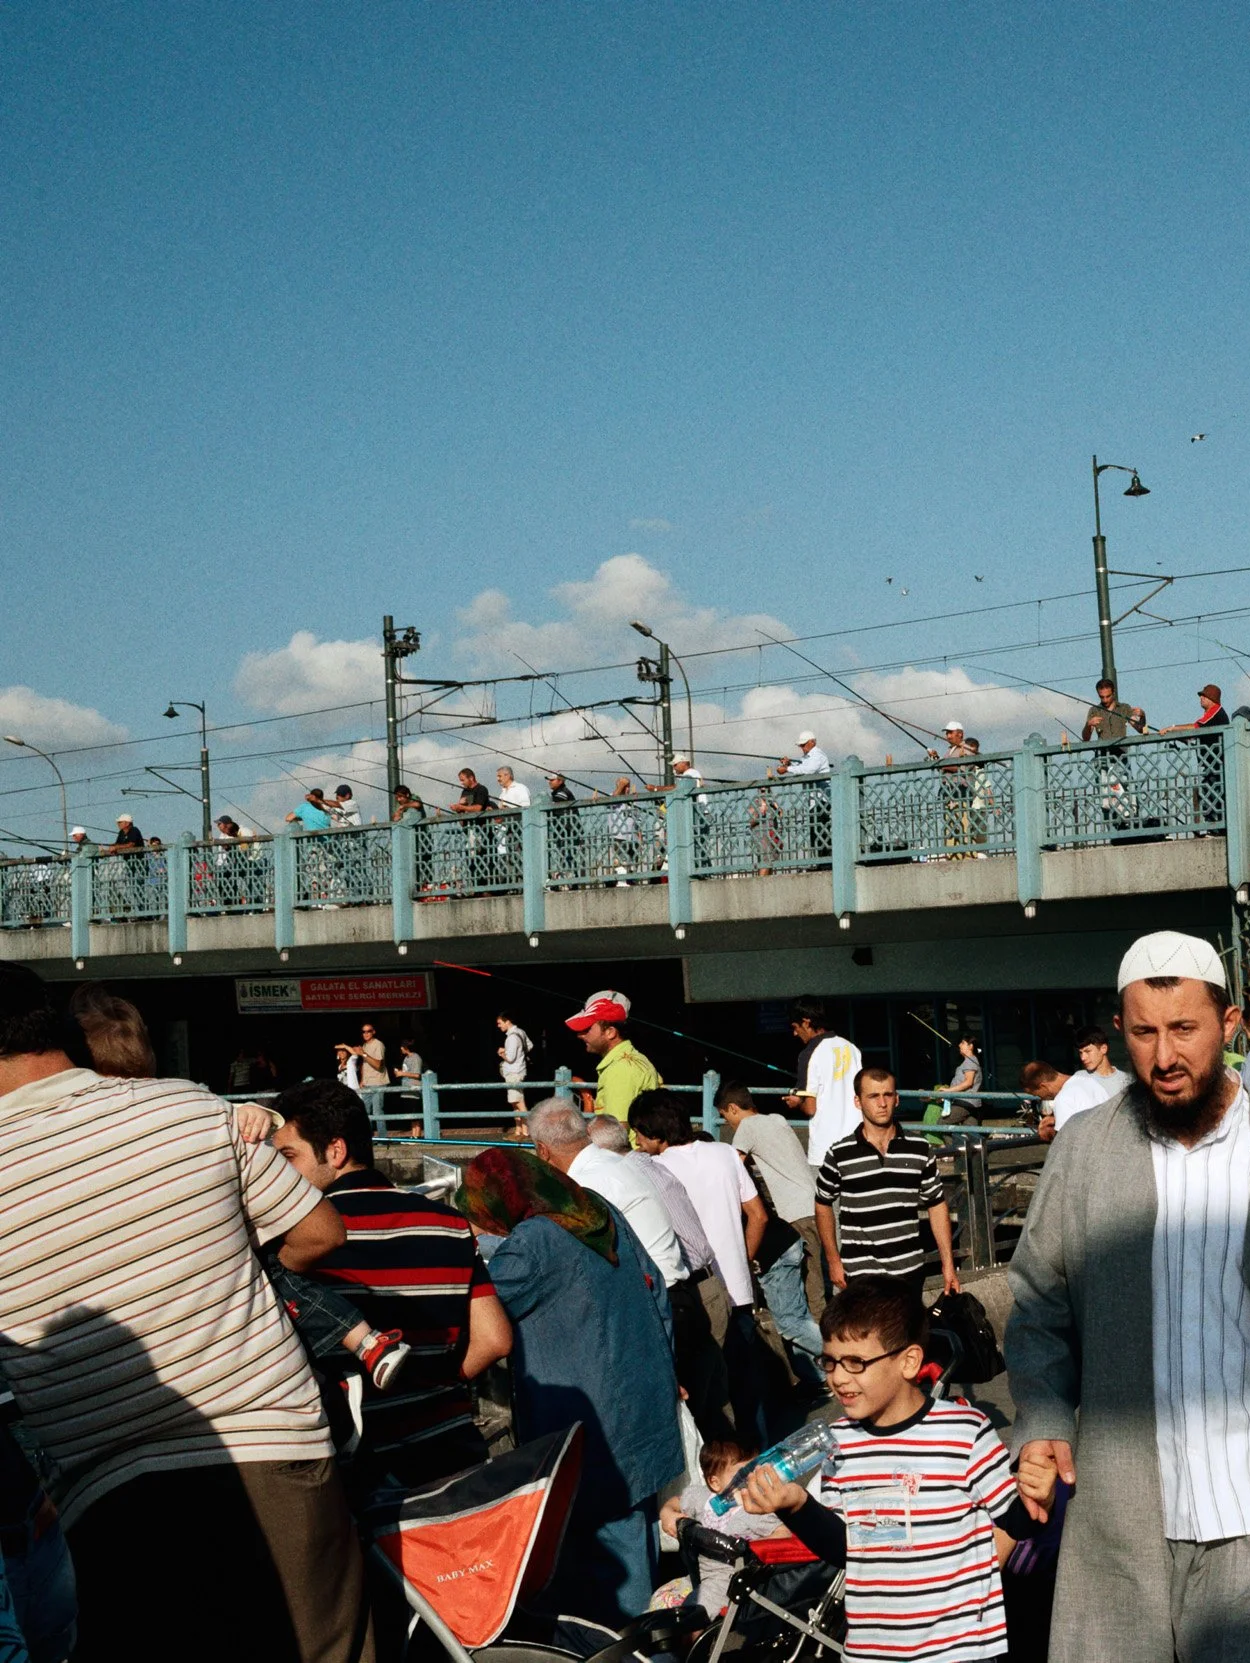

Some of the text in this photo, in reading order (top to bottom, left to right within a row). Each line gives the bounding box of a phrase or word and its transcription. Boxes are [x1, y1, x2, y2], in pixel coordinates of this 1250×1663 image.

[310, 981, 346, 992] GALATA
[348, 981, 361, 991] EL
[436, 1560, 493, 1583] BABY MAX
